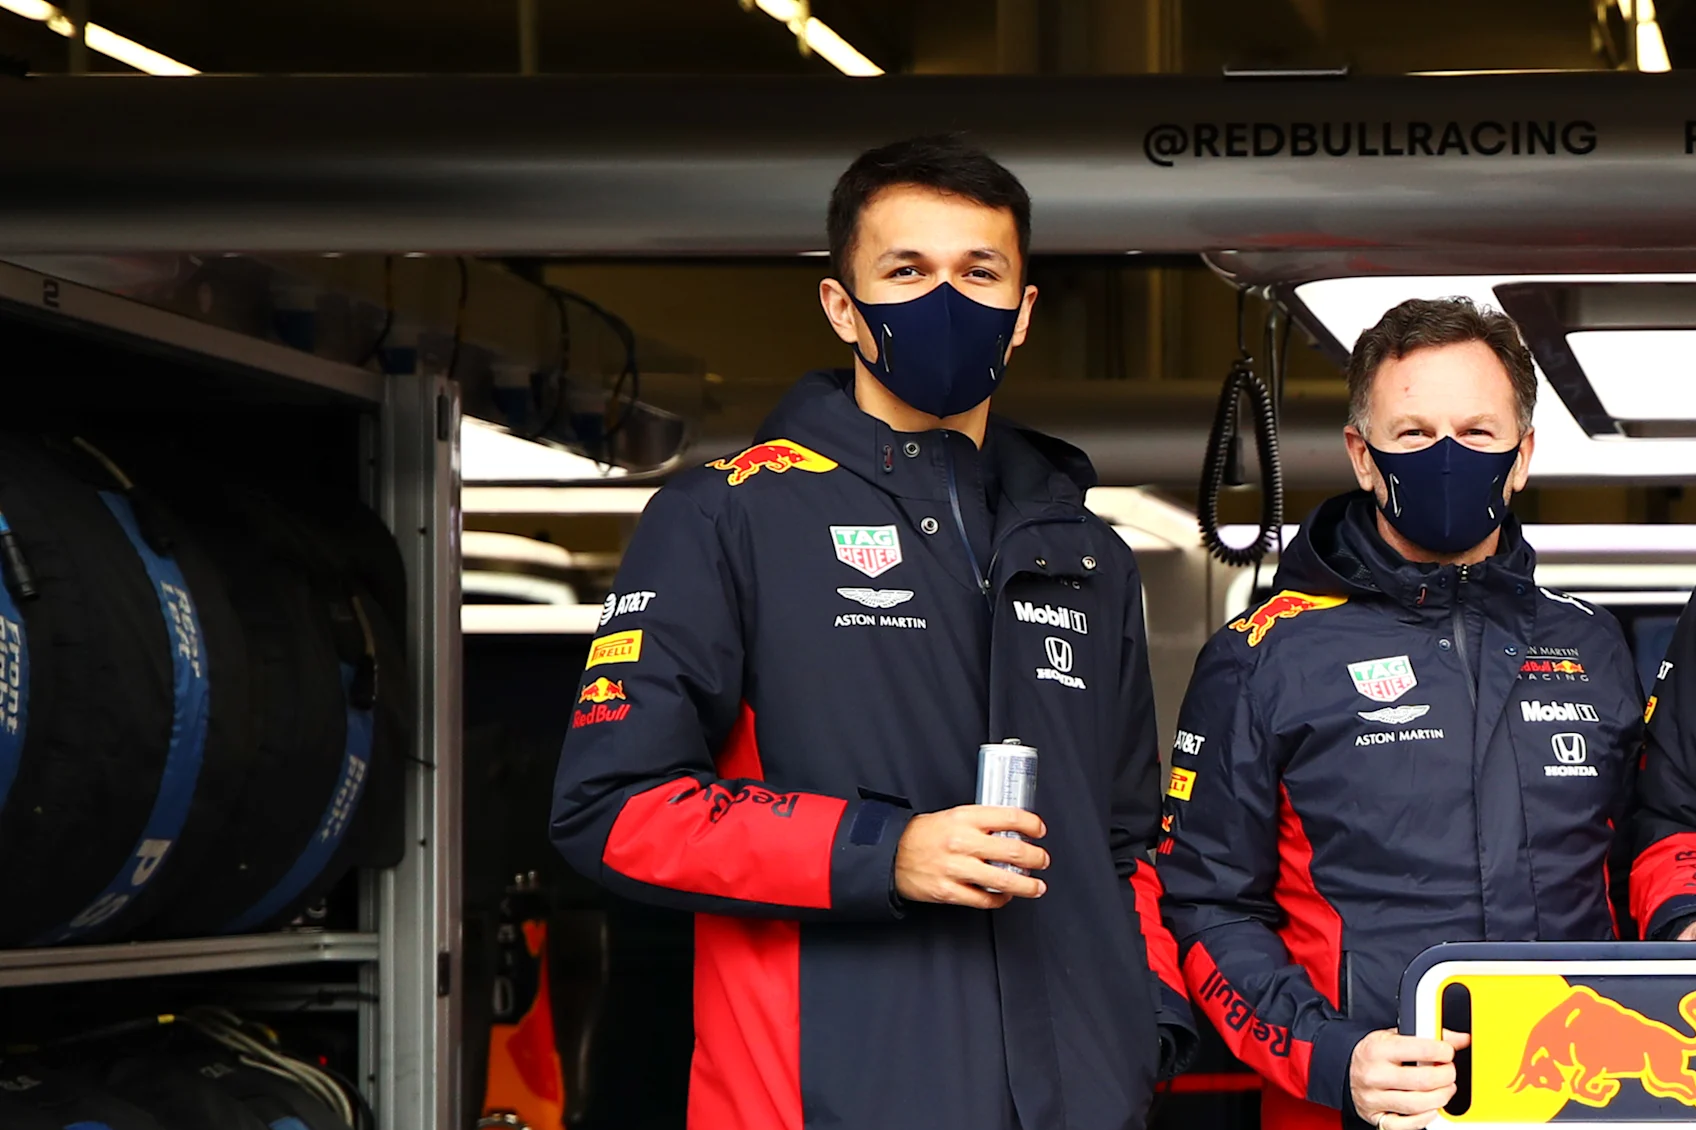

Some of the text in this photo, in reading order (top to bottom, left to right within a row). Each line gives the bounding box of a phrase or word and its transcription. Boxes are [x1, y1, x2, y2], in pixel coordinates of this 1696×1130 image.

[1142, 119, 1599, 168] @REDBULLRACING
[836, 529, 894, 546] TAG
[839, 547, 898, 574] HEUER
[614, 591, 656, 617] AT&T
[1013, 600, 1071, 629] Mobil
[834, 614, 927, 629] ASTON MARTIN
[591, 637, 635, 662] PIRELLI
[1539, 646, 1579, 657] MARTIN
[5, 619, 21, 736] Front
[1036, 668, 1086, 690] HONDA
[1353, 660, 1409, 682] TAG
[1358, 675, 1413, 699] HEUER
[1520, 700, 1580, 722] Mobil
[1173, 730, 1205, 756] AT&T
[1355, 728, 1444, 747] ASTON MARTIN
[1544, 765, 1598, 777] HONDA
